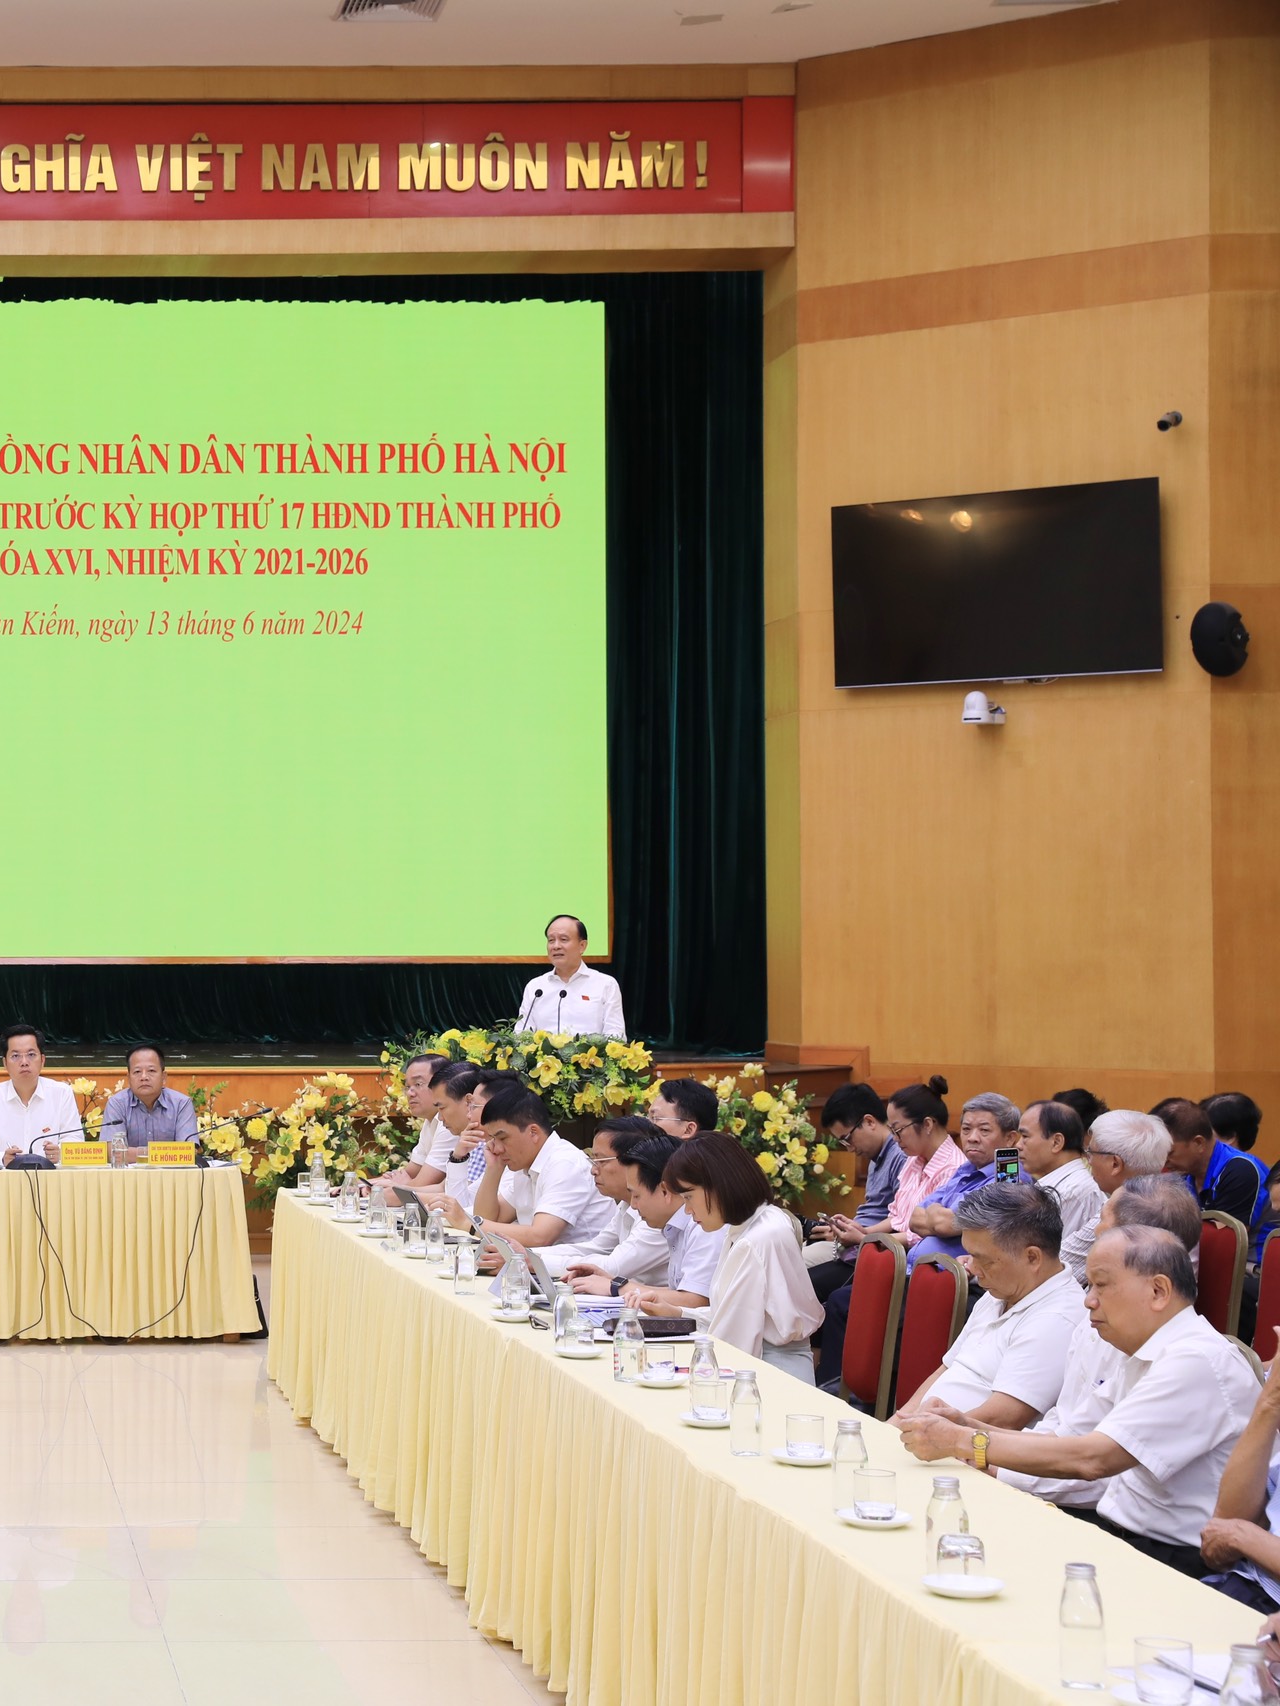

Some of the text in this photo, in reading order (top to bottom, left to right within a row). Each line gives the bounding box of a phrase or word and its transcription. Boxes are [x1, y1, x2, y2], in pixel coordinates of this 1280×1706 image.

[136, 132, 243, 201] VIỆT
[261, 143, 381, 191] NAM
[398, 132, 549, 191] MUÔN
[77, 433, 171, 475] NHÂN
[178, 433, 247, 475] DÂN
[252, 433, 370, 474] THÀNH
[377, 432, 447, 474] PHỐ
[454, 432, 501, 474] HÀ
[508, 437, 568, 482] NỘI
[103, 494, 143, 530] KỲ
[149, 502, 209, 537] HỌP
[211, 493, 276, 529] THỨ
[279, 502, 305, 529] 17
[311, 502, 392, 529] HĐND
[395, 493, 496, 529] THÀNH
[502, 492, 563, 529] PHỐ
[44, 547, 102, 580] XVI,
[106, 544, 201, 583] NHIỆM
[207, 539, 248, 575] KỲ
[253, 547, 370, 575] 2021-2026
[21, 604, 81, 638] Kiếm,
[88, 610, 140, 642] ngày
[146, 610, 171, 636] 13
[177, 610, 237, 642] tháng
[242, 610, 256, 635] 6
[261, 610, 306, 635] năm
[311, 610, 365, 635] 2024
